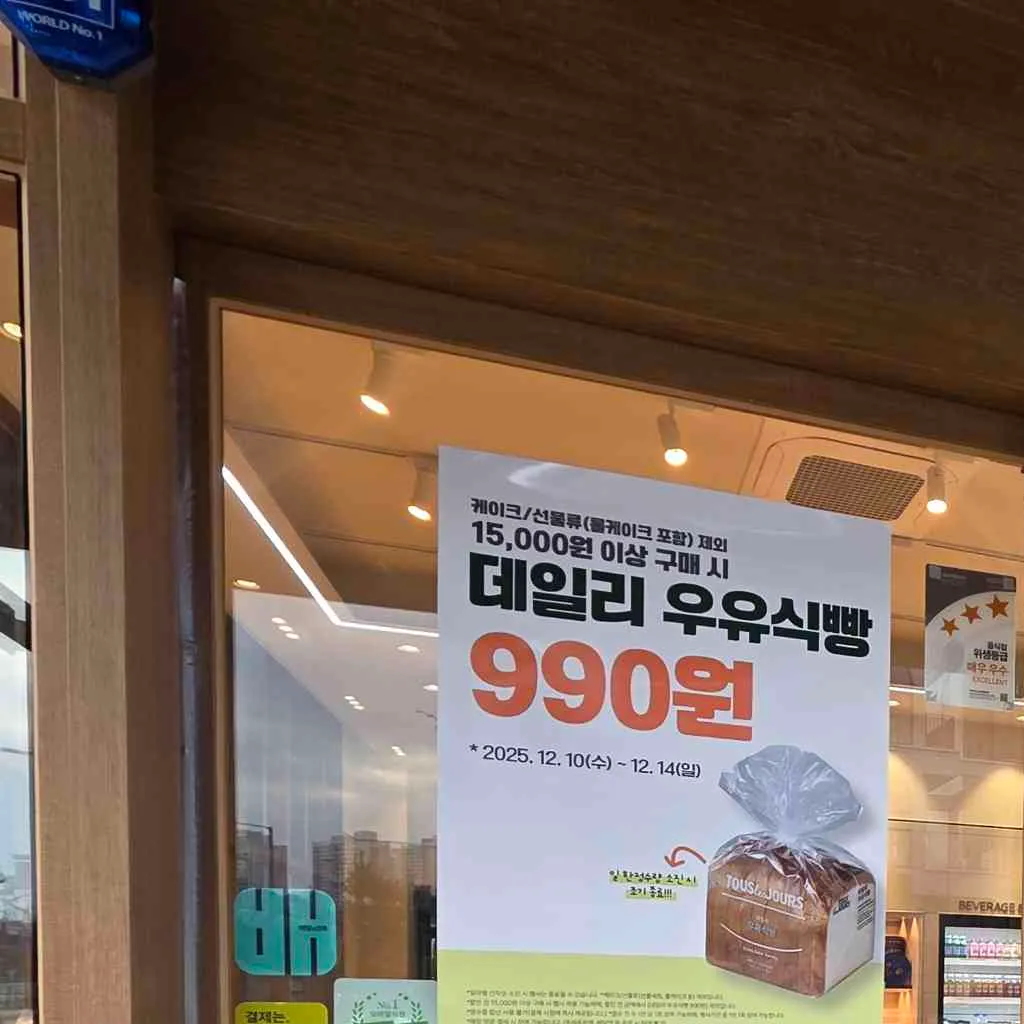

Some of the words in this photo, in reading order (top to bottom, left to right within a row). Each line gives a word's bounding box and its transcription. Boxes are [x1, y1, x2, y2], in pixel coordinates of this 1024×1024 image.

[17, 9, 70, 30] WORLD
[472, 521, 593, 560] 15,000원
[600, 541, 648, 567] 이상
[655, 549, 700, 575] 구매
[707, 558, 729, 579] 시
[656, 527, 693, 548] 포함)
[698, 535, 728, 552] 제외
[469, 552, 644, 627] 데일리
[663, 582, 873, 658] 우유식빵
[974, 648, 1008, 662] 위생등급
[967, 662, 987, 676] 매우
[990, 663, 1009, 677] 우수
[470, 632, 753, 742] 990원
[483, 746, 533, 765] 2025.
[538, 751, 561, 768] 12.
[566, 752, 612, 771] 10(수)
[631, 758, 654, 774] 12.
[657, 760, 701, 779] 14(일)
[958, 901, 1016, 914] BEVERAGE
